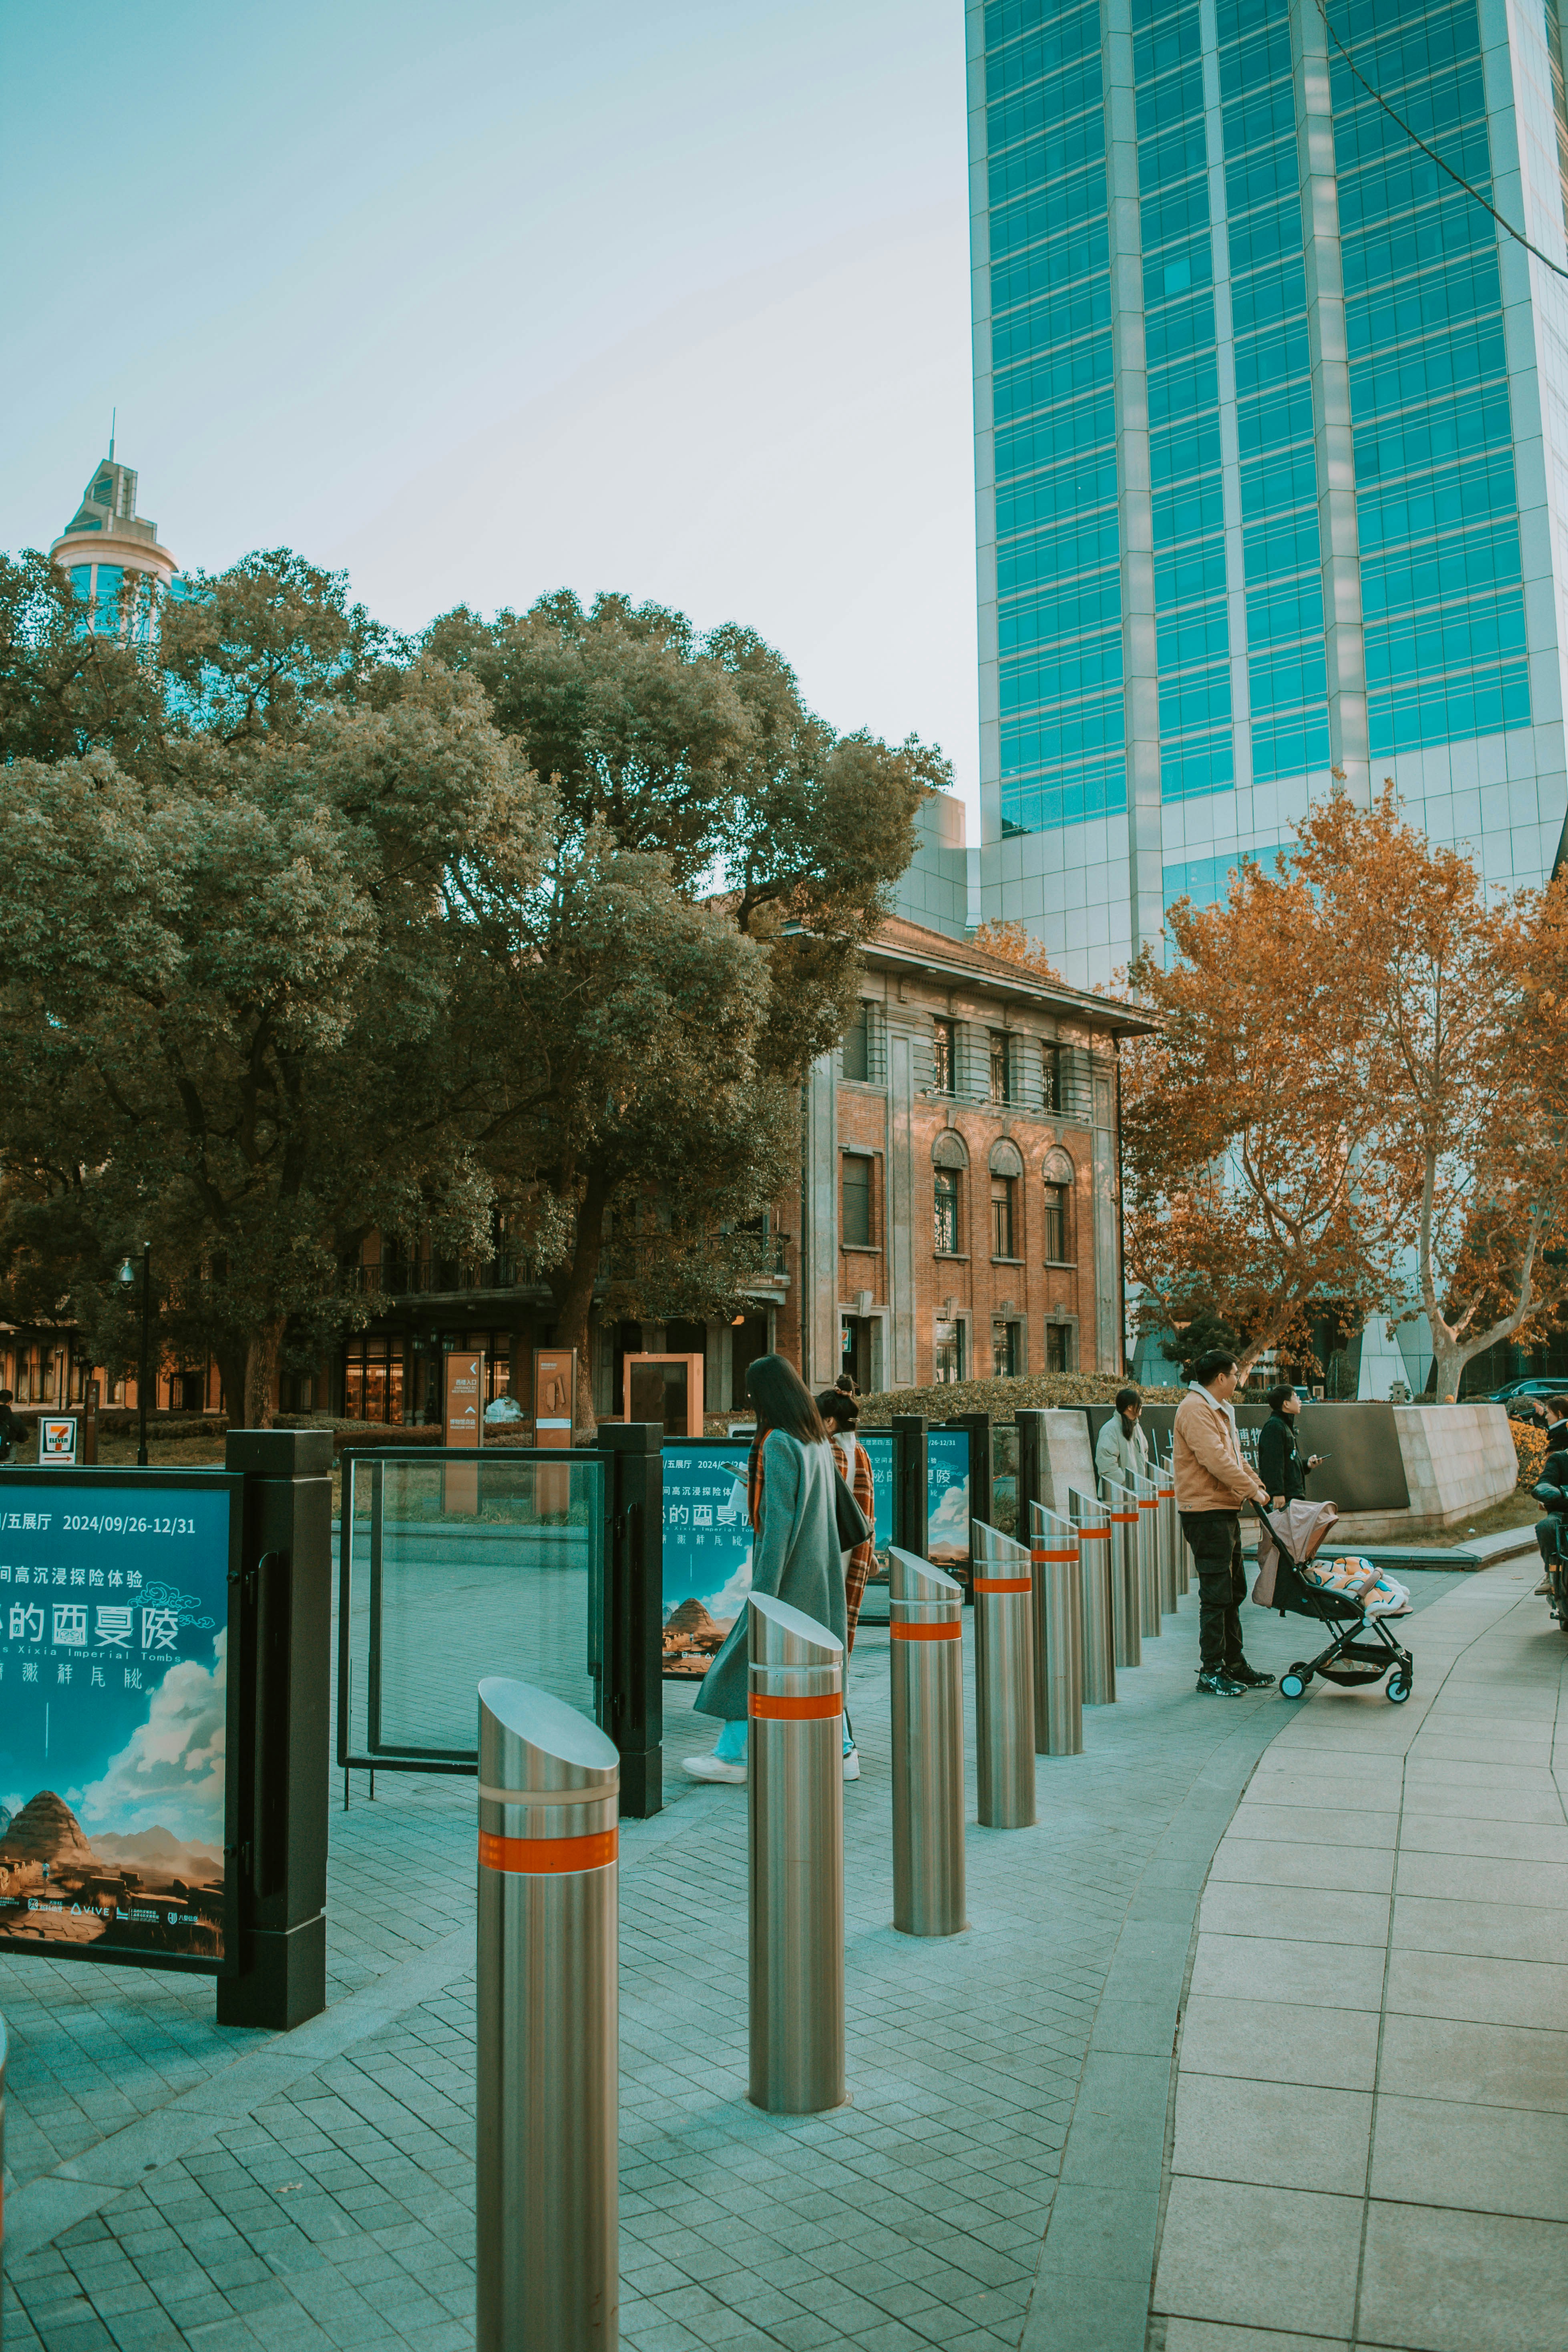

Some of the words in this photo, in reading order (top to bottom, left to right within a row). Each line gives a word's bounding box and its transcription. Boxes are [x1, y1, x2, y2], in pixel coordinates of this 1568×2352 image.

[50, 1426, 68, 1451] 7
[63, 1515, 195, 1536] 2024/09/26-12/31
[18, 1645, 57, 1655] Xixia
[68, 1648, 129, 1660] Imperial
[141, 1652, 181, 1662] Tombs
[84, 1906, 109, 1916] VIVE
